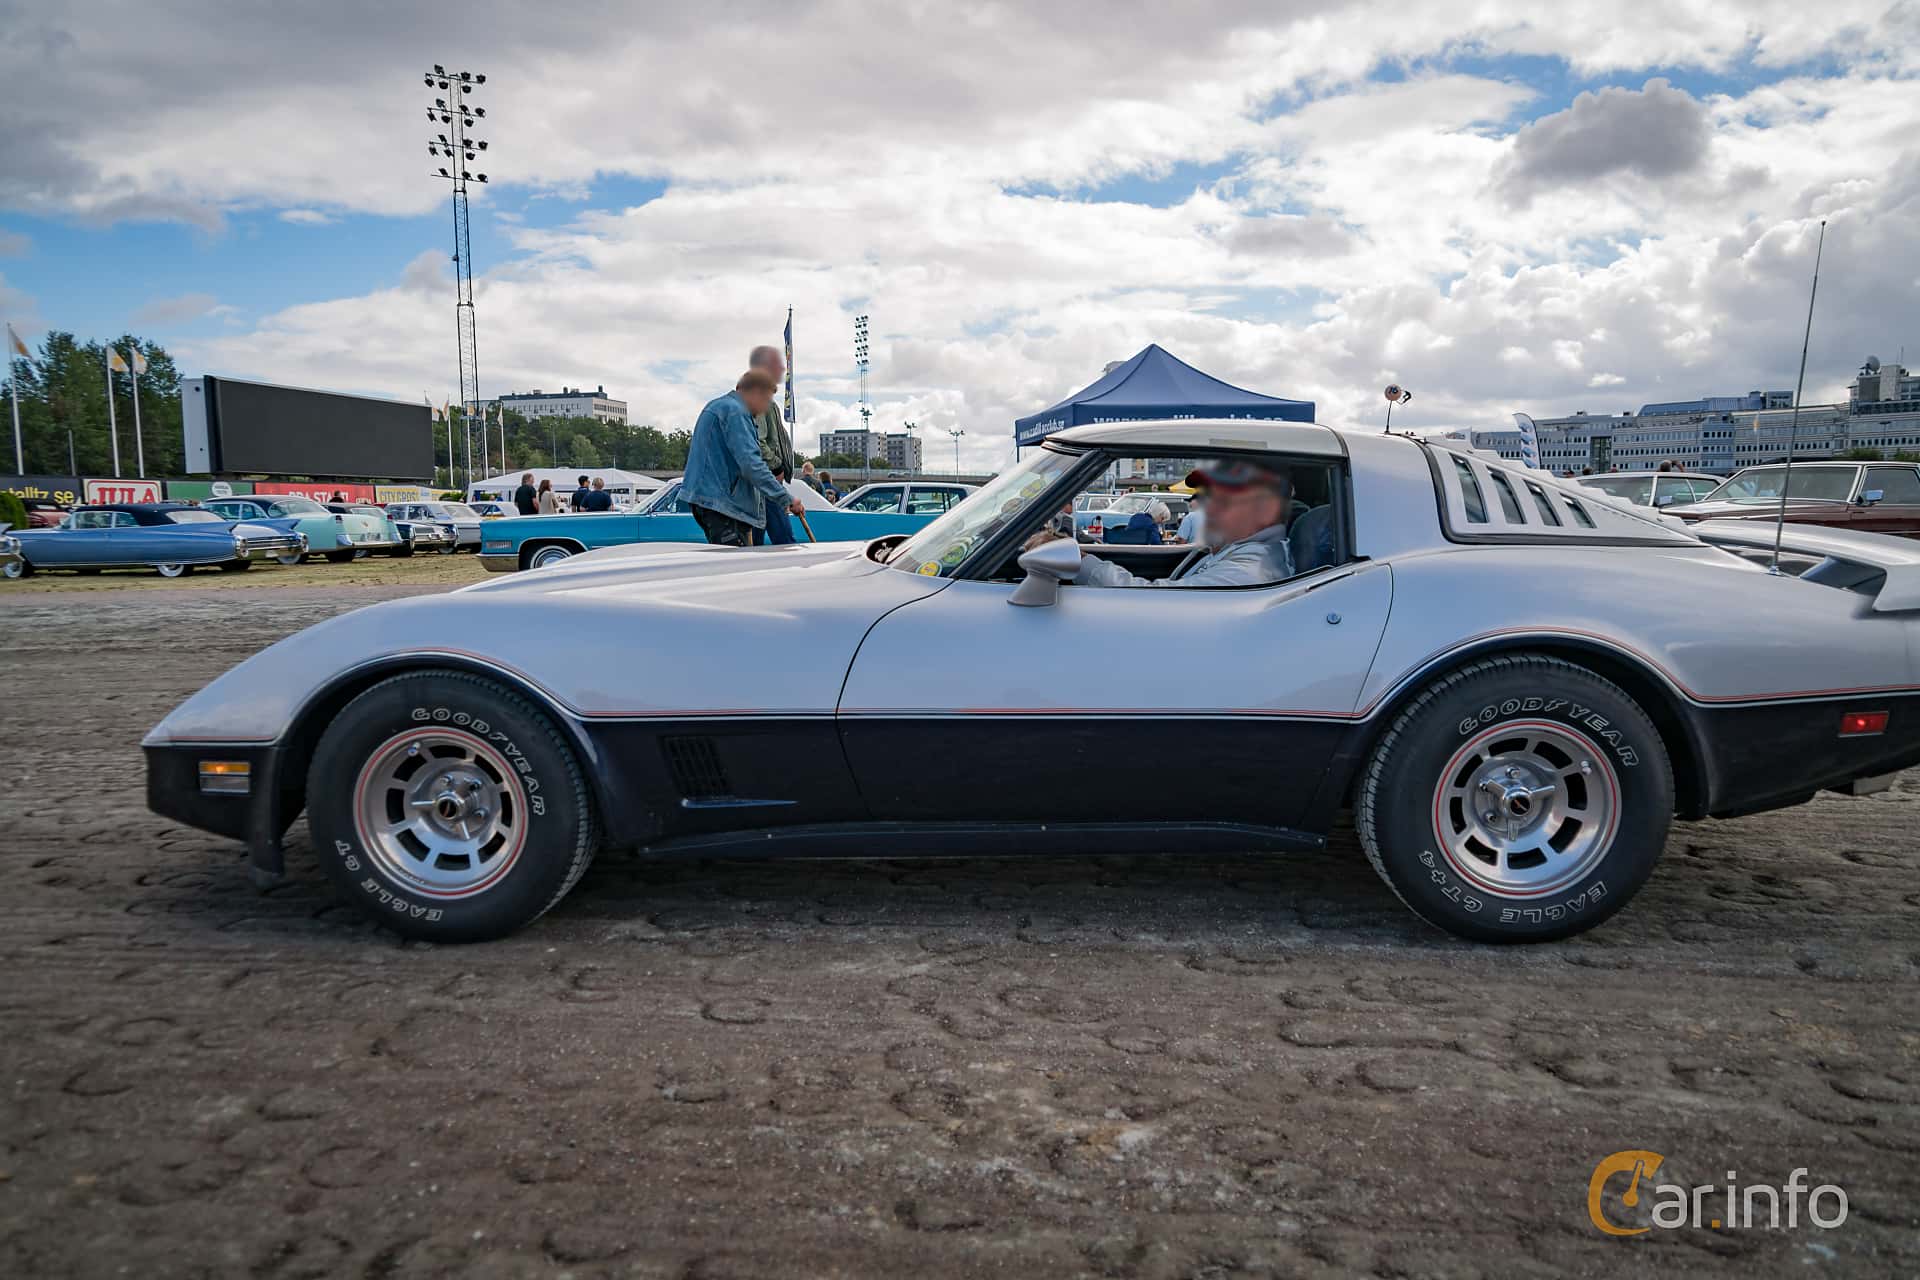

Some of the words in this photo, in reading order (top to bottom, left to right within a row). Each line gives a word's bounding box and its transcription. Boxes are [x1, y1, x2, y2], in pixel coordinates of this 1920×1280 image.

[90, 487, 156, 504] JULA
[1459, 697, 1639, 767] GOODYEAR
[411, 708, 545, 816] GOODYEAR
[335, 839, 361, 871] GT
[361, 878, 444, 921] EAGLE
[1418, 851, 1483, 912] GT+4
[1500, 881, 1608, 923] EAGLE
